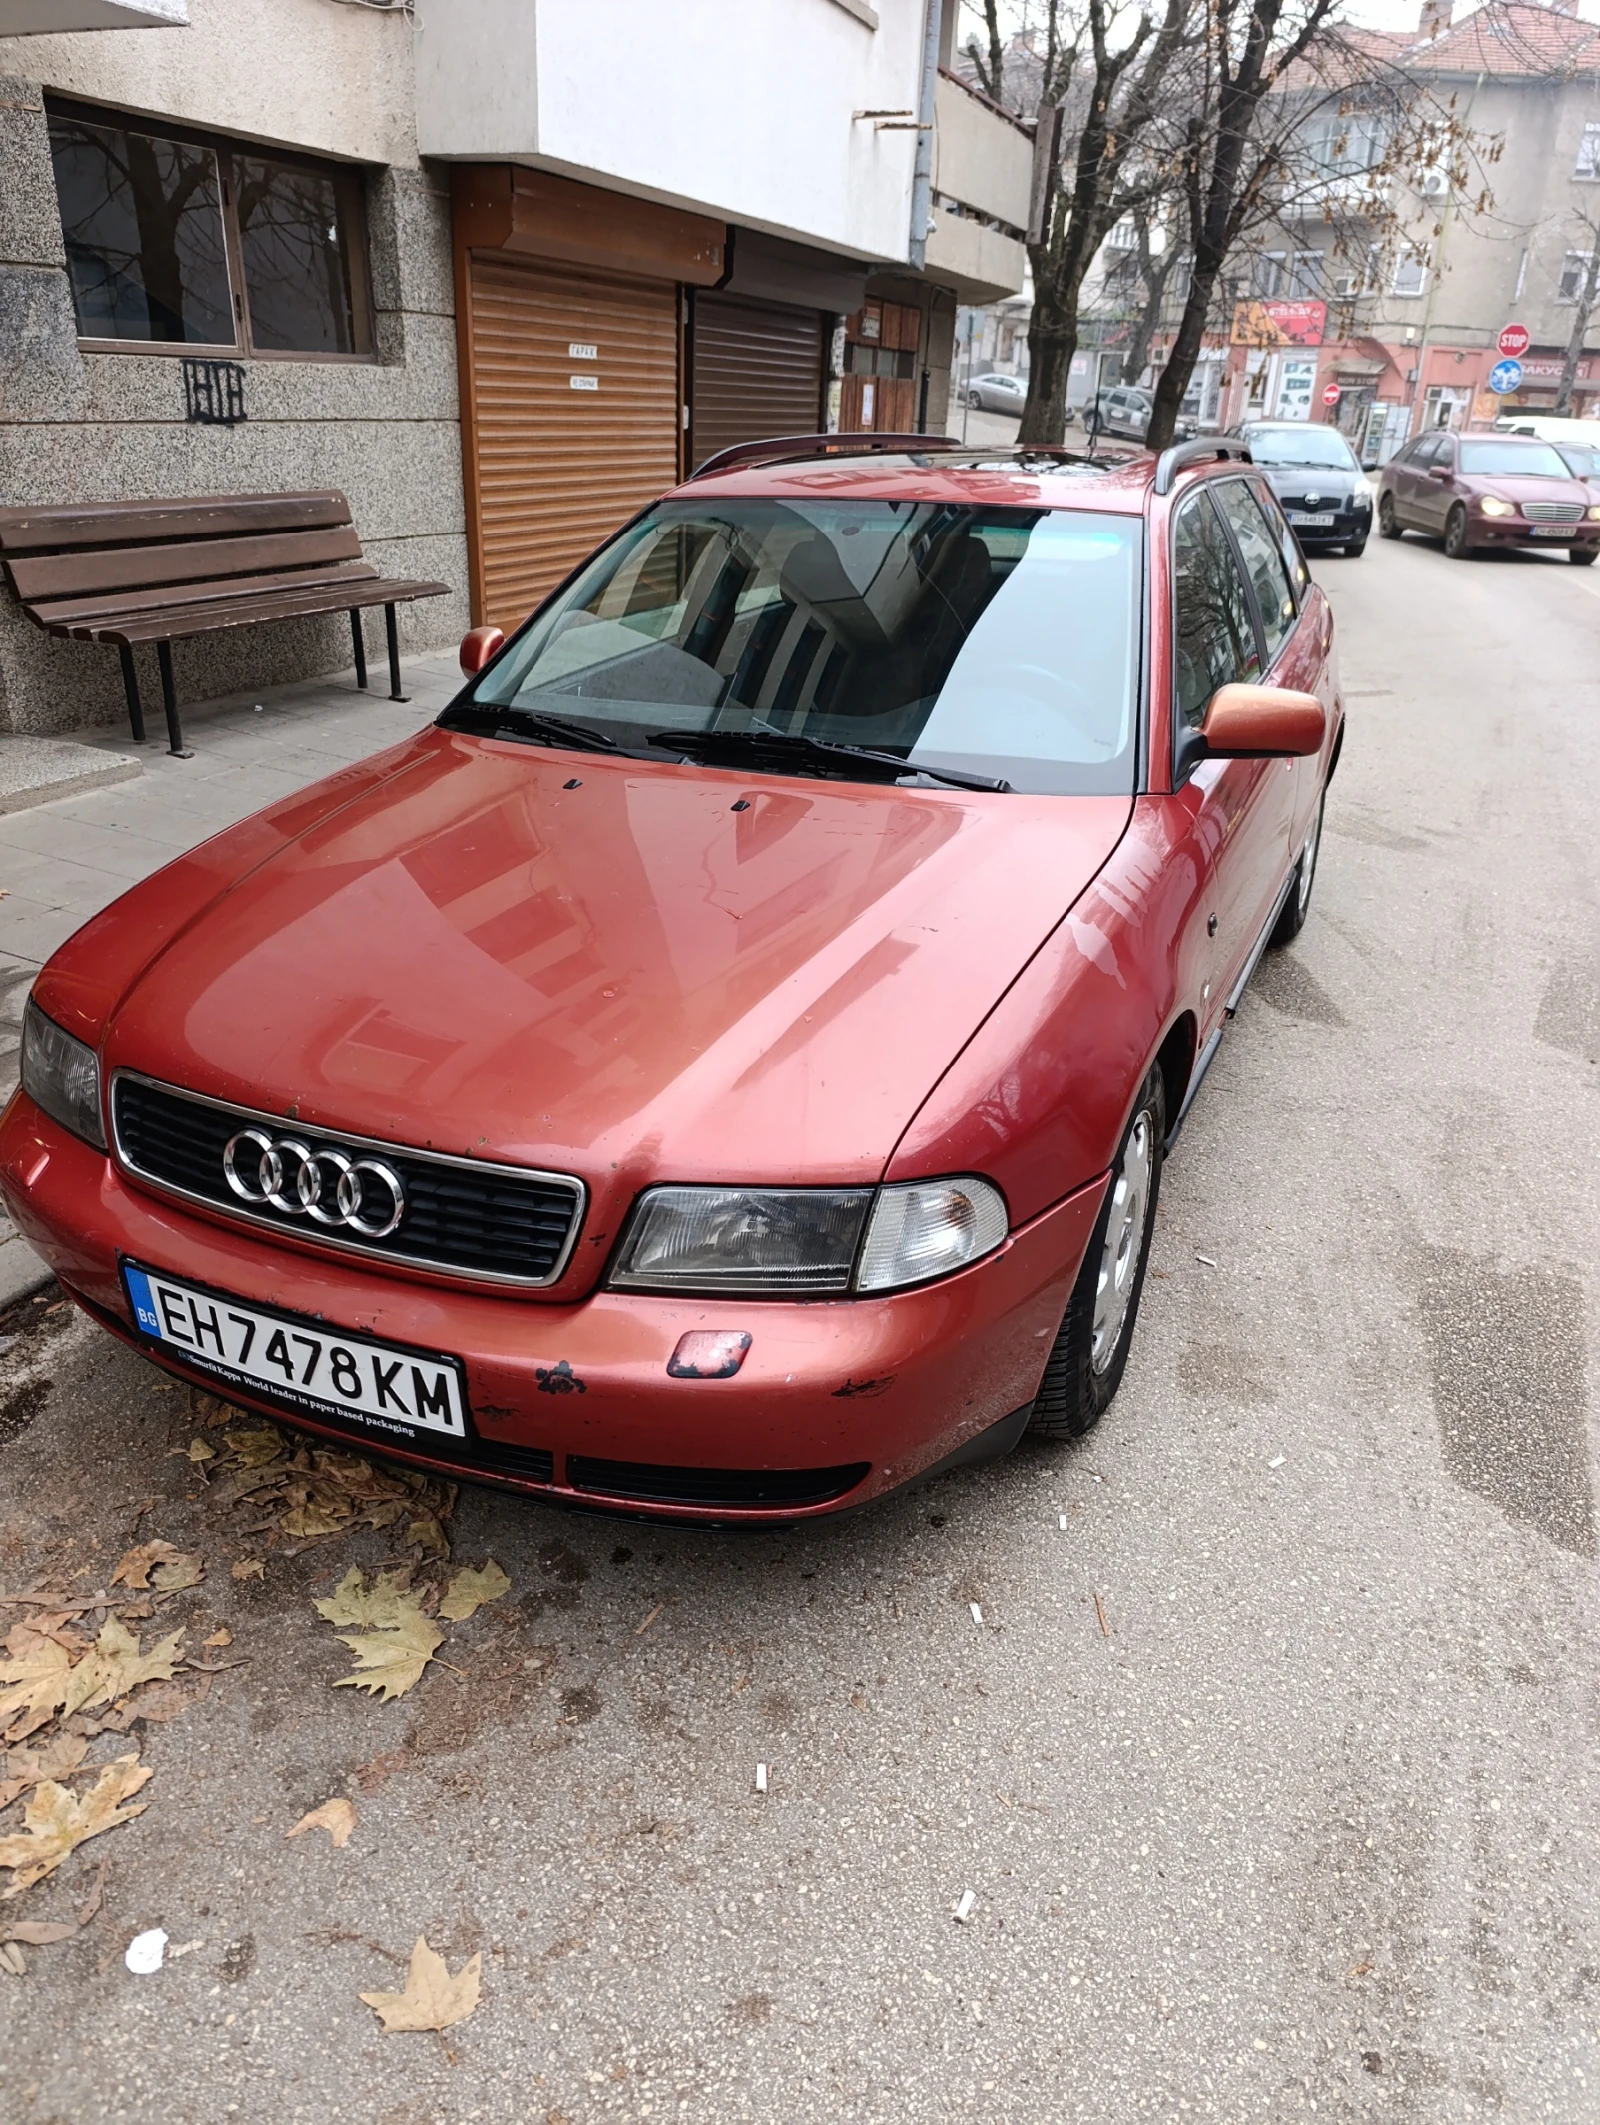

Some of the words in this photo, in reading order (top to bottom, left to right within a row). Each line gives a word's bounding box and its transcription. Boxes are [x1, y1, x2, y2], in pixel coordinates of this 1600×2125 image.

[1500, 334, 1527, 347] STOP
[137, 1307, 157, 1327] BG
[217, 1366, 241, 1382] Kappa
[243, 1376, 269, 1392] World
[270, 1385, 297, 1401] leader
[298, 1394, 308, 1405] in
[310, 1400, 336, 1413] paper
[337, 1406, 364, 1422] based
[365, 1417, 415, 1438] packaging
